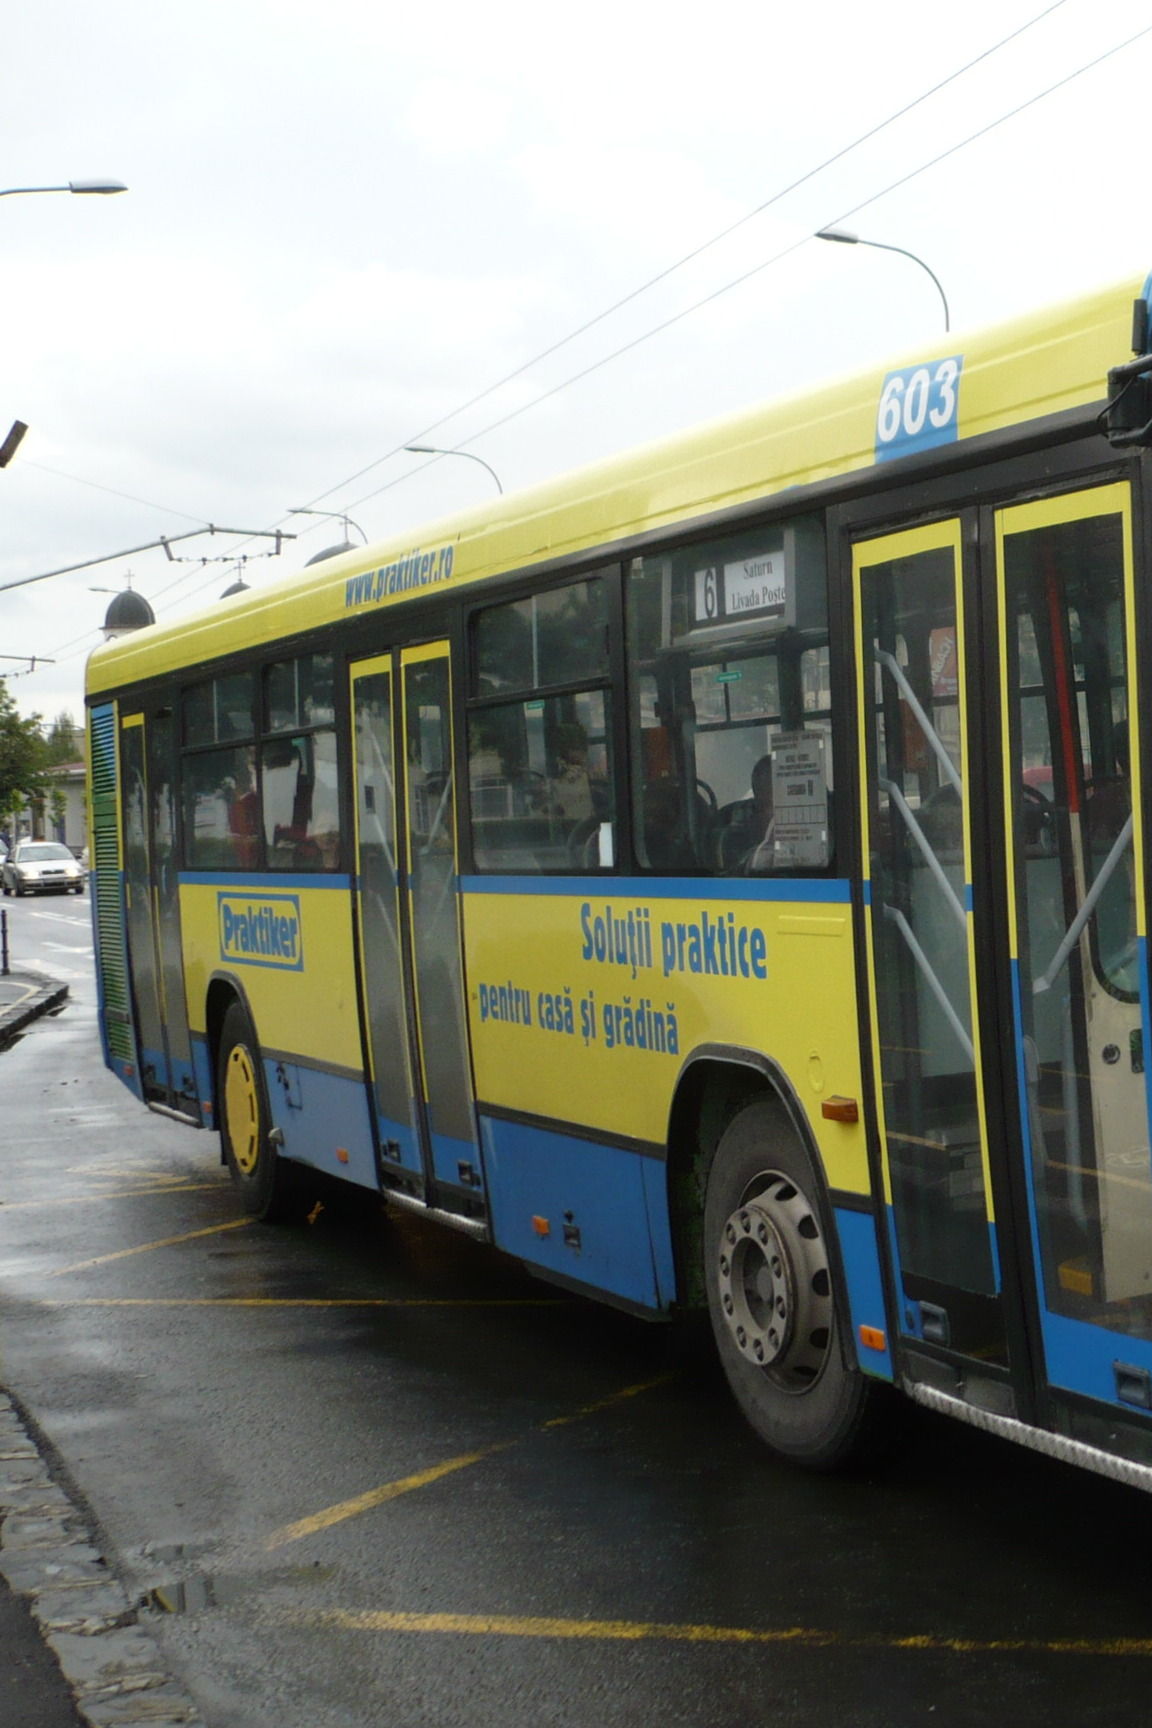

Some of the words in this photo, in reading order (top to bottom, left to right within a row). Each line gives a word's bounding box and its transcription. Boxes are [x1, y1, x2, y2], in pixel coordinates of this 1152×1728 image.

[878, 359, 957, 443] 603
[345, 545, 454, 608] www.praktiker.ro
[704, 568, 715, 618] 6
[743, 560, 773, 580] Saturn
[732, 589, 760, 611] Livada
[223, 903, 298, 958] Praktiker
[660, 911, 767, 979] praktice
[479, 980, 532, 1026] pentru
[538, 986, 575, 1035] casă
